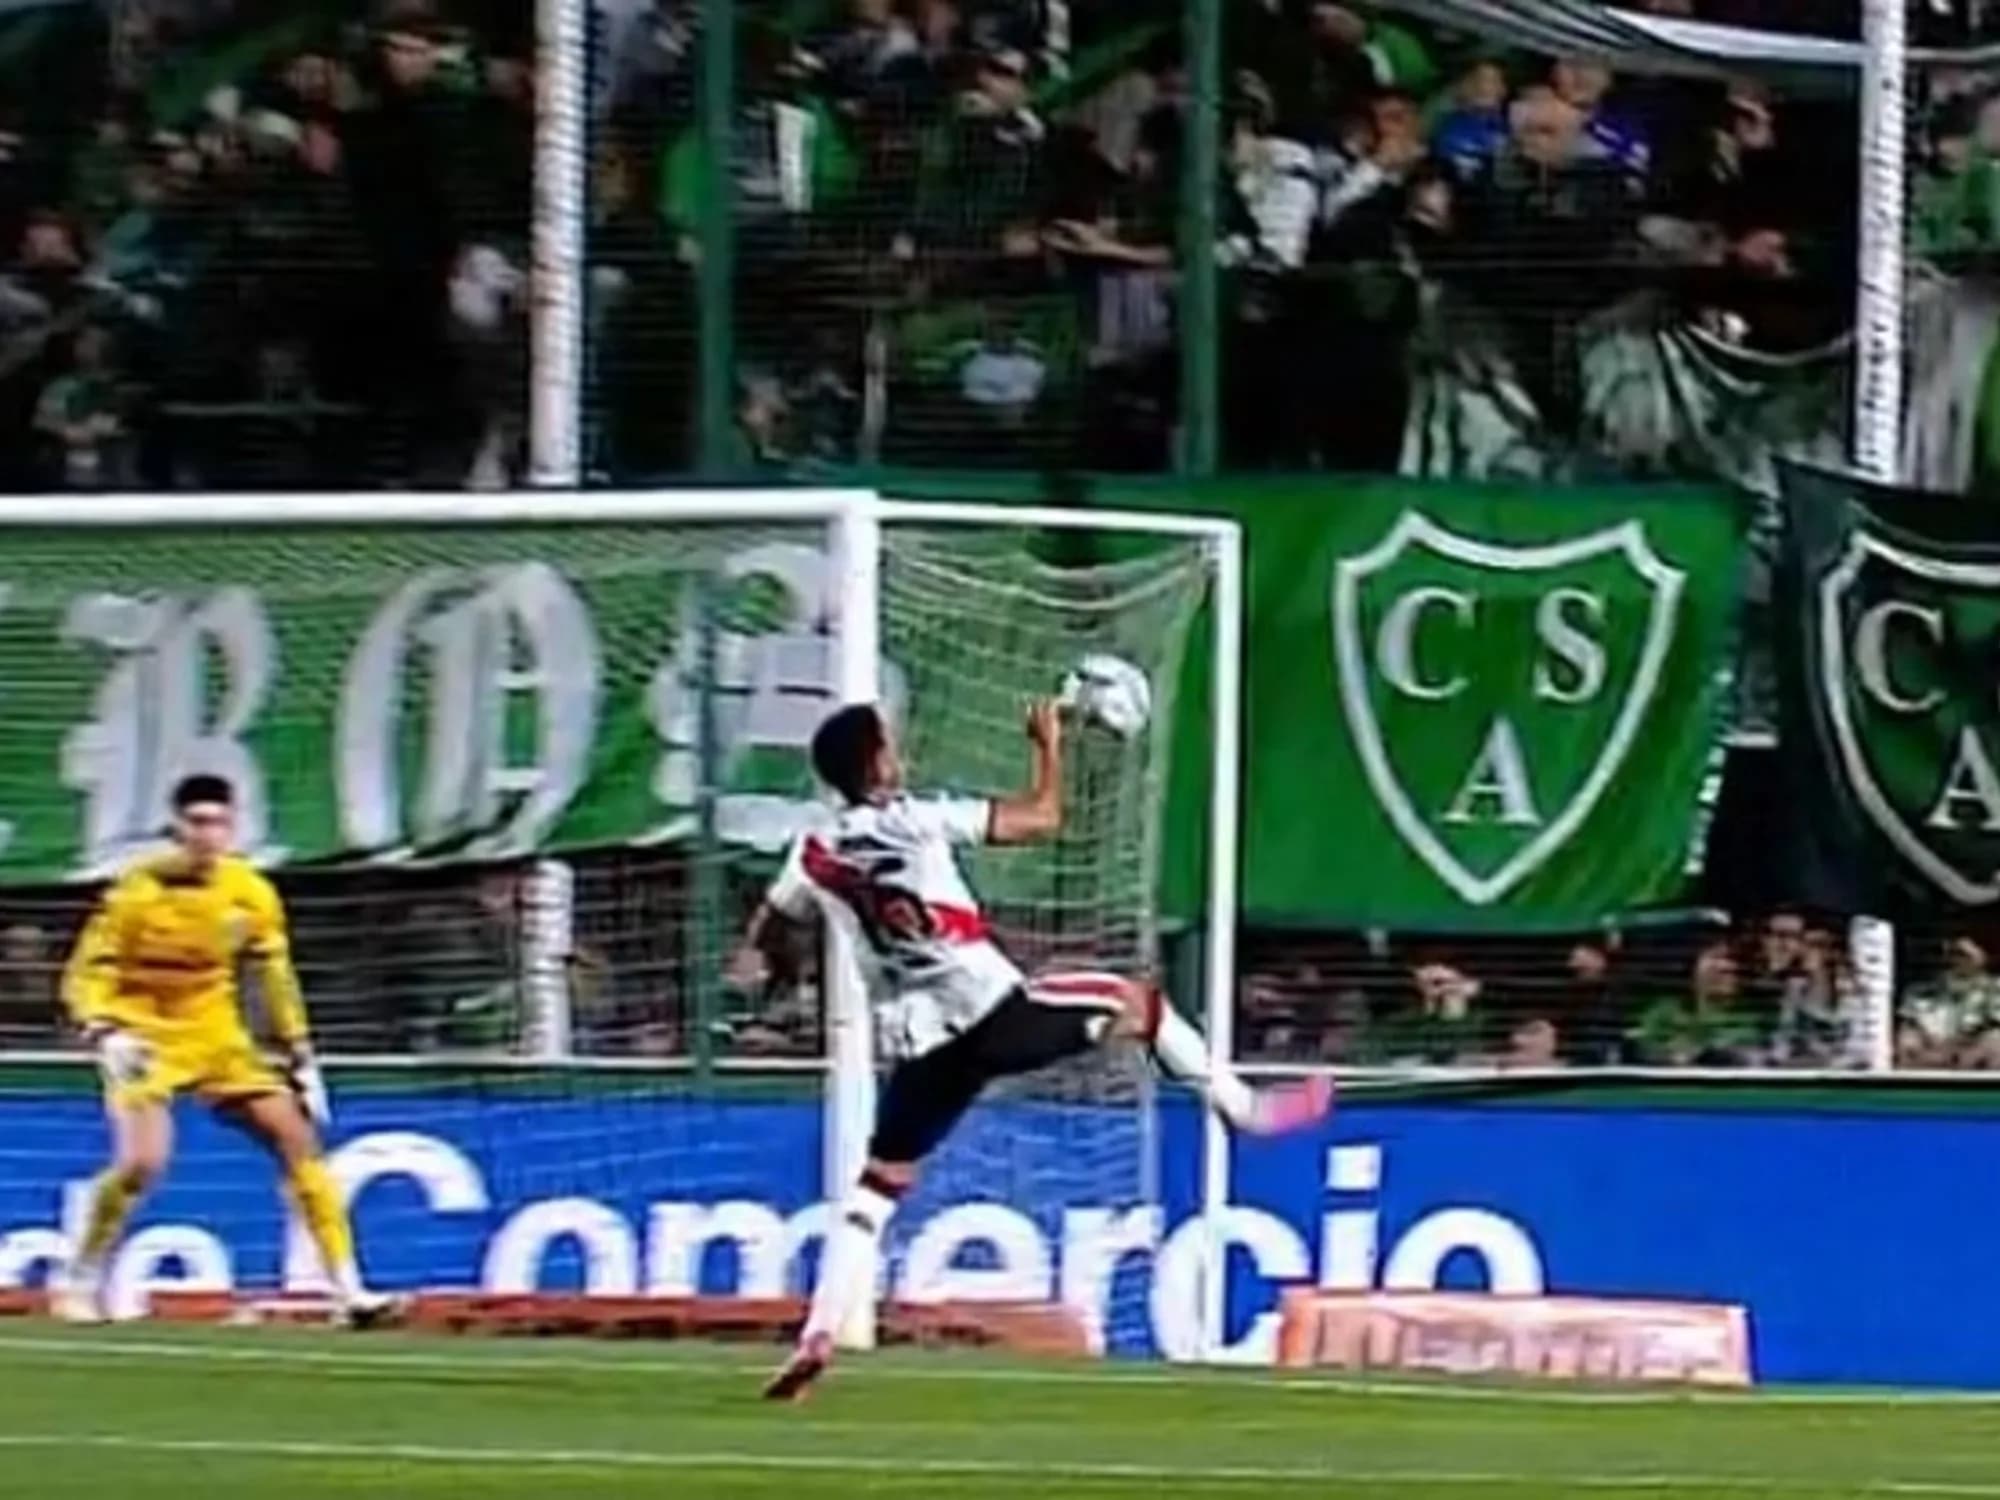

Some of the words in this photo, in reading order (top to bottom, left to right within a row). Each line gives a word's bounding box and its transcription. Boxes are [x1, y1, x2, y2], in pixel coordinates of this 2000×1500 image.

[1376, 587, 1476, 699] C
[1533, 587, 1608, 701] S
[1443, 715, 1543, 824] A
[283, 1130, 1546, 1365] Comercio
